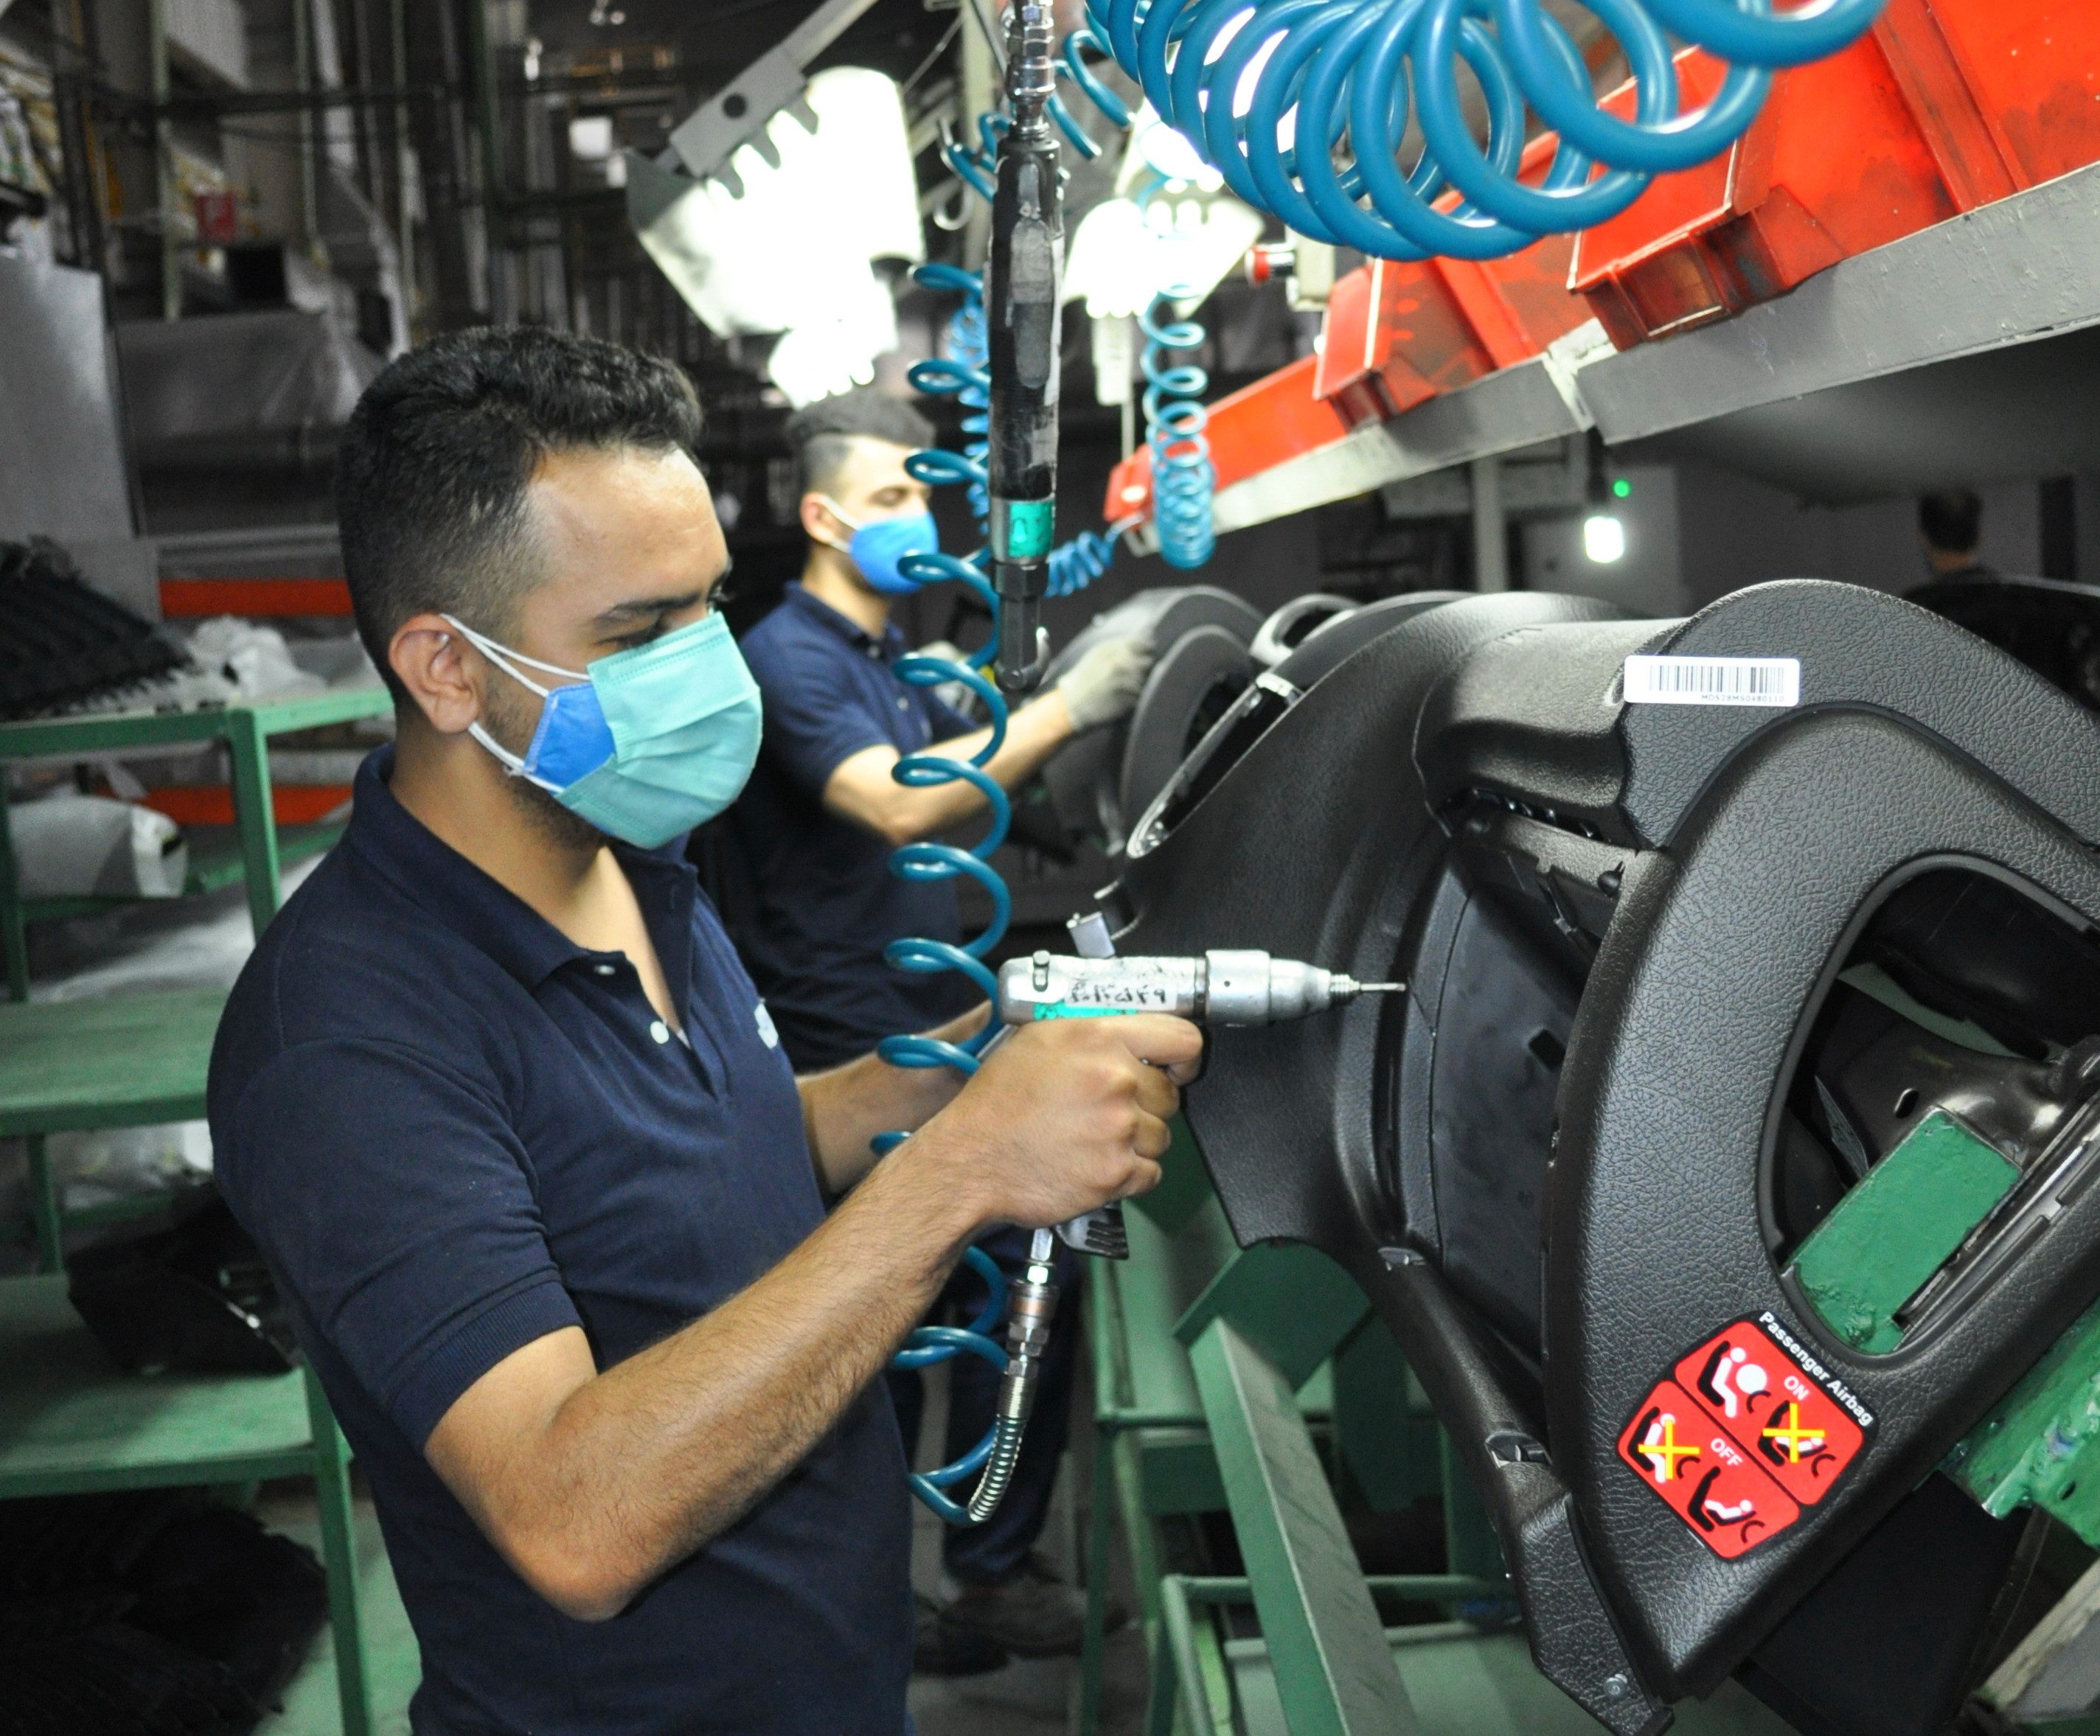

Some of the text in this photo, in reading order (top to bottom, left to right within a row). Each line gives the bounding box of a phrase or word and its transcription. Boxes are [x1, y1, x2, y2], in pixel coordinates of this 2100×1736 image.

[1759, 1311, 1874, 1426] Passenger Airbag
[1784, 1376, 1809, 1401] ON
[1710, 1437, 1744, 1467] OFF
